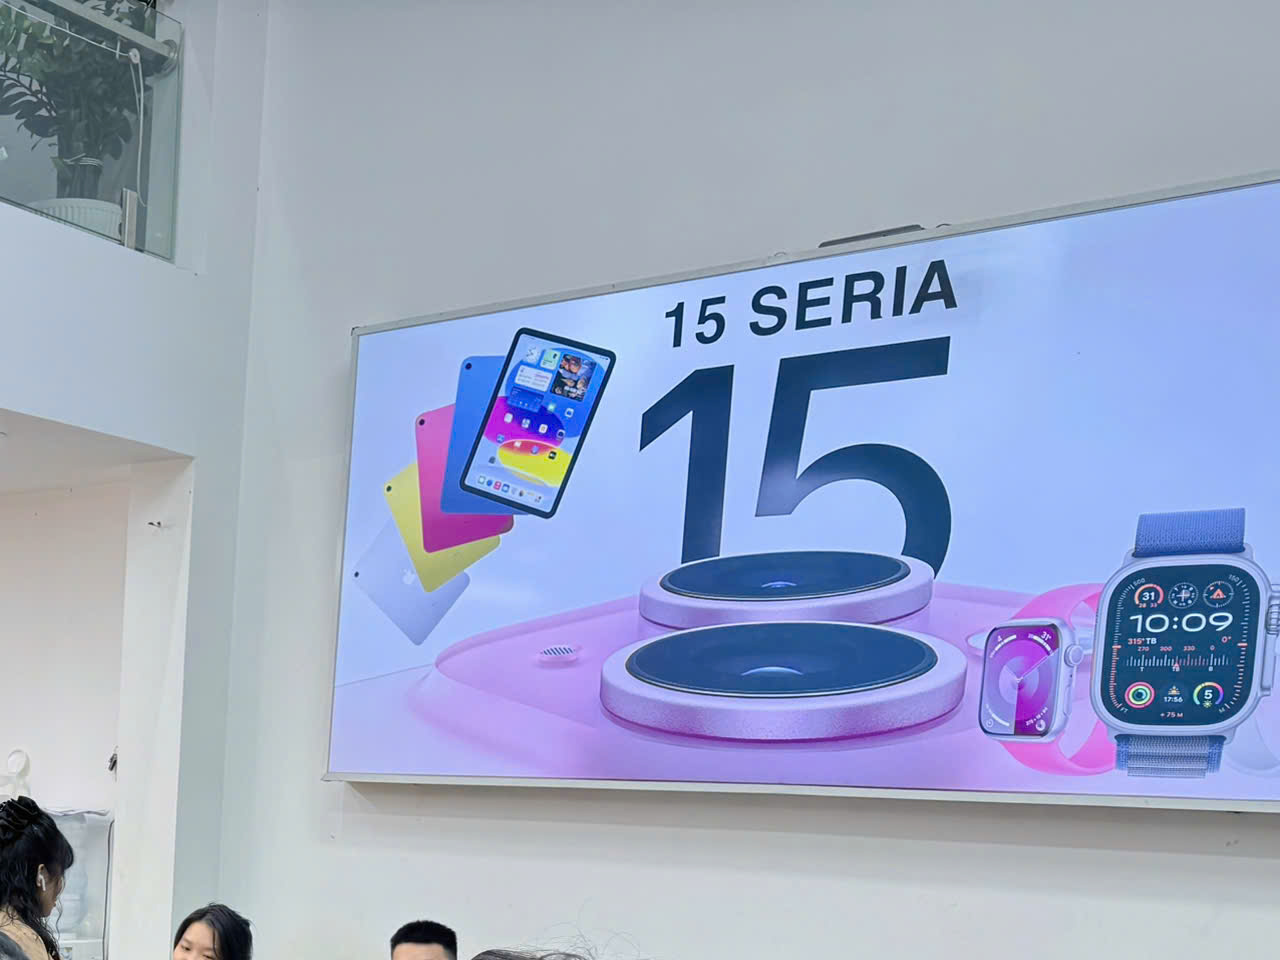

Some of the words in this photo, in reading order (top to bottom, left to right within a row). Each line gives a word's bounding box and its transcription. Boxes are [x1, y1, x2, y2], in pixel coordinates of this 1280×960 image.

[665, 295, 727, 348] 15
[748, 258, 958, 337] SERIA
[638, 335, 953, 580] 15
[1142, 591, 1156, 601] 31
[1128, 612, 1234, 633] 10:09
[1204, 690, 1213, 700] 5
